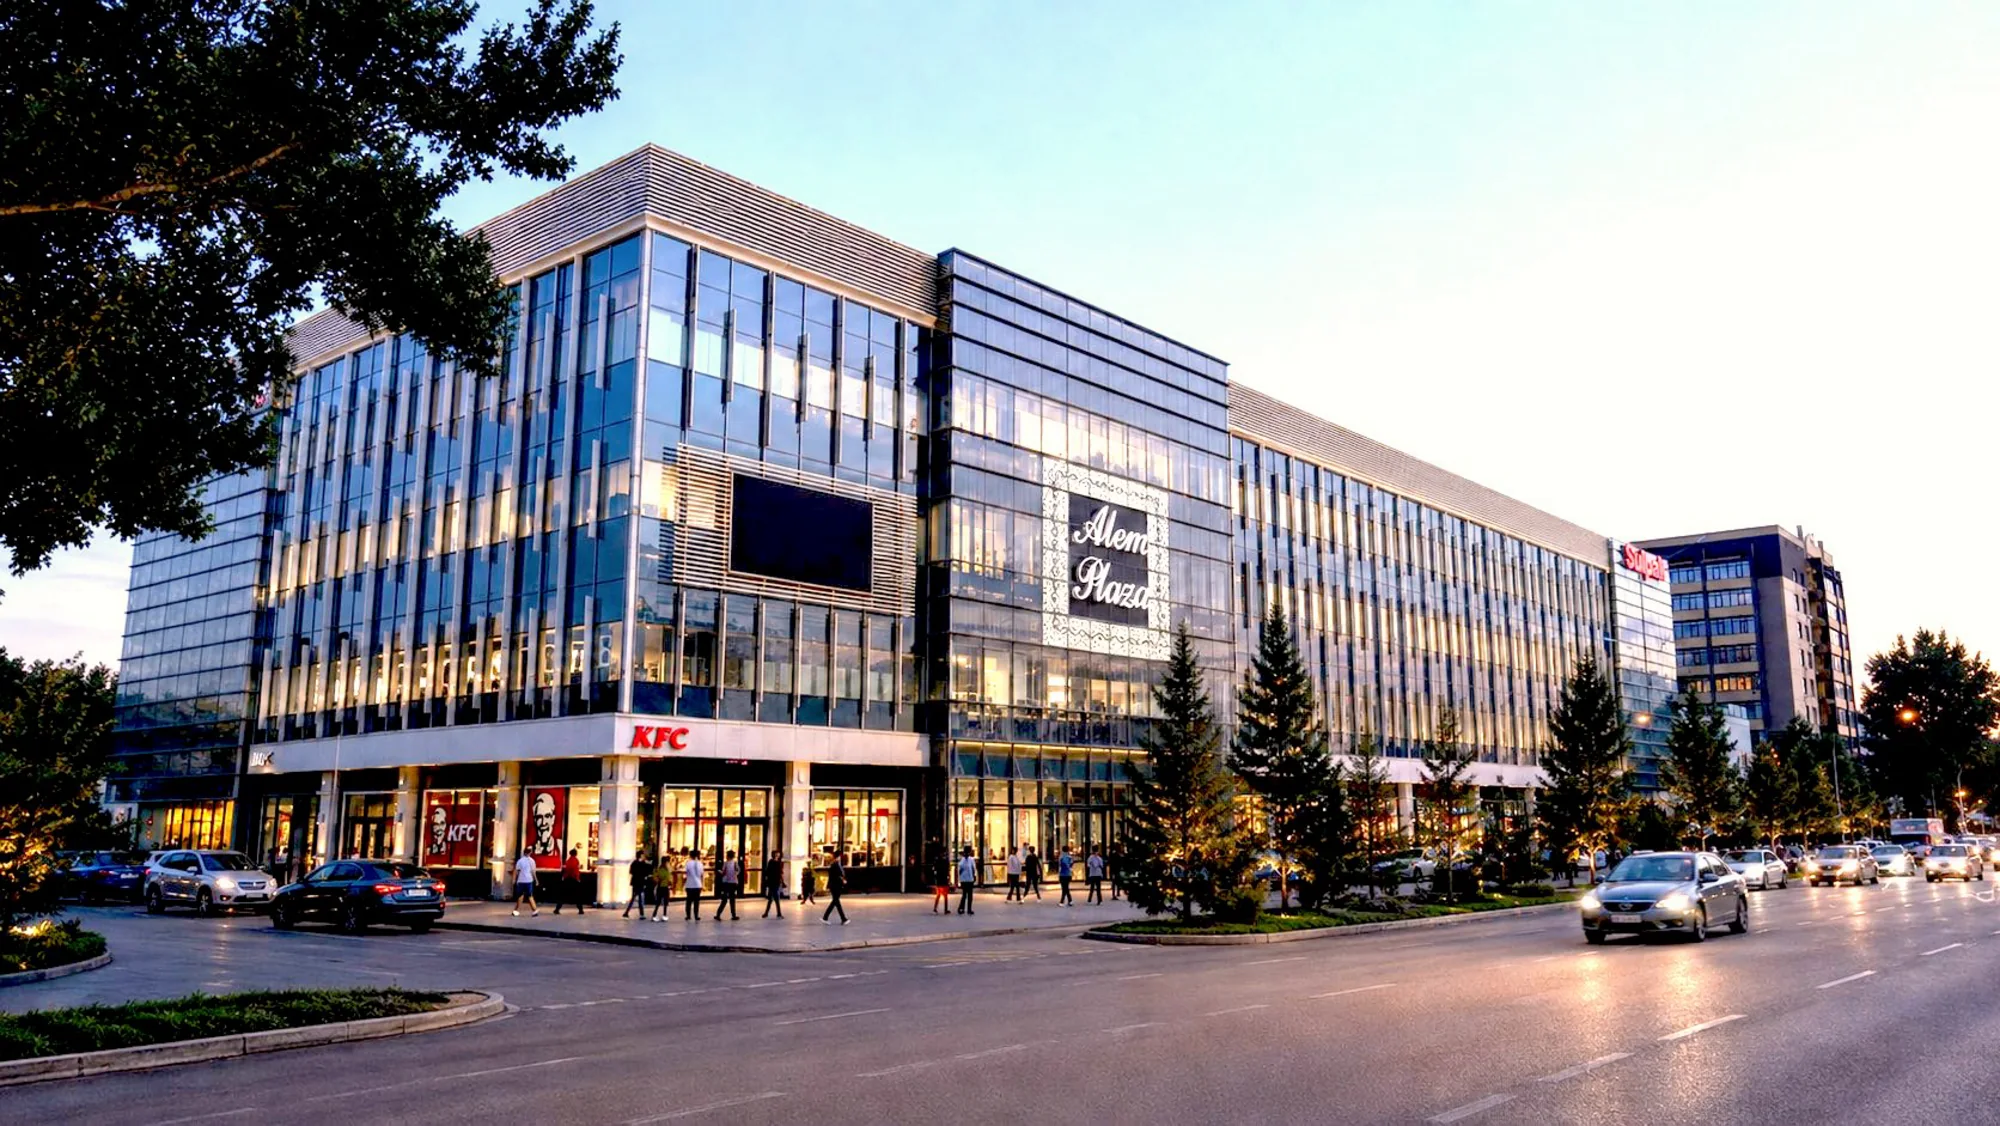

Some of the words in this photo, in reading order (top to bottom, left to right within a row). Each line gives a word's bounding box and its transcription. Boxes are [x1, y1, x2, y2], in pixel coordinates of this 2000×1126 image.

[1072, 505, 1149, 556] Alem
[1072, 555, 1154, 610] Plaza
[631, 725, 689, 750] KFC
[447, 824, 477, 842] KFC
